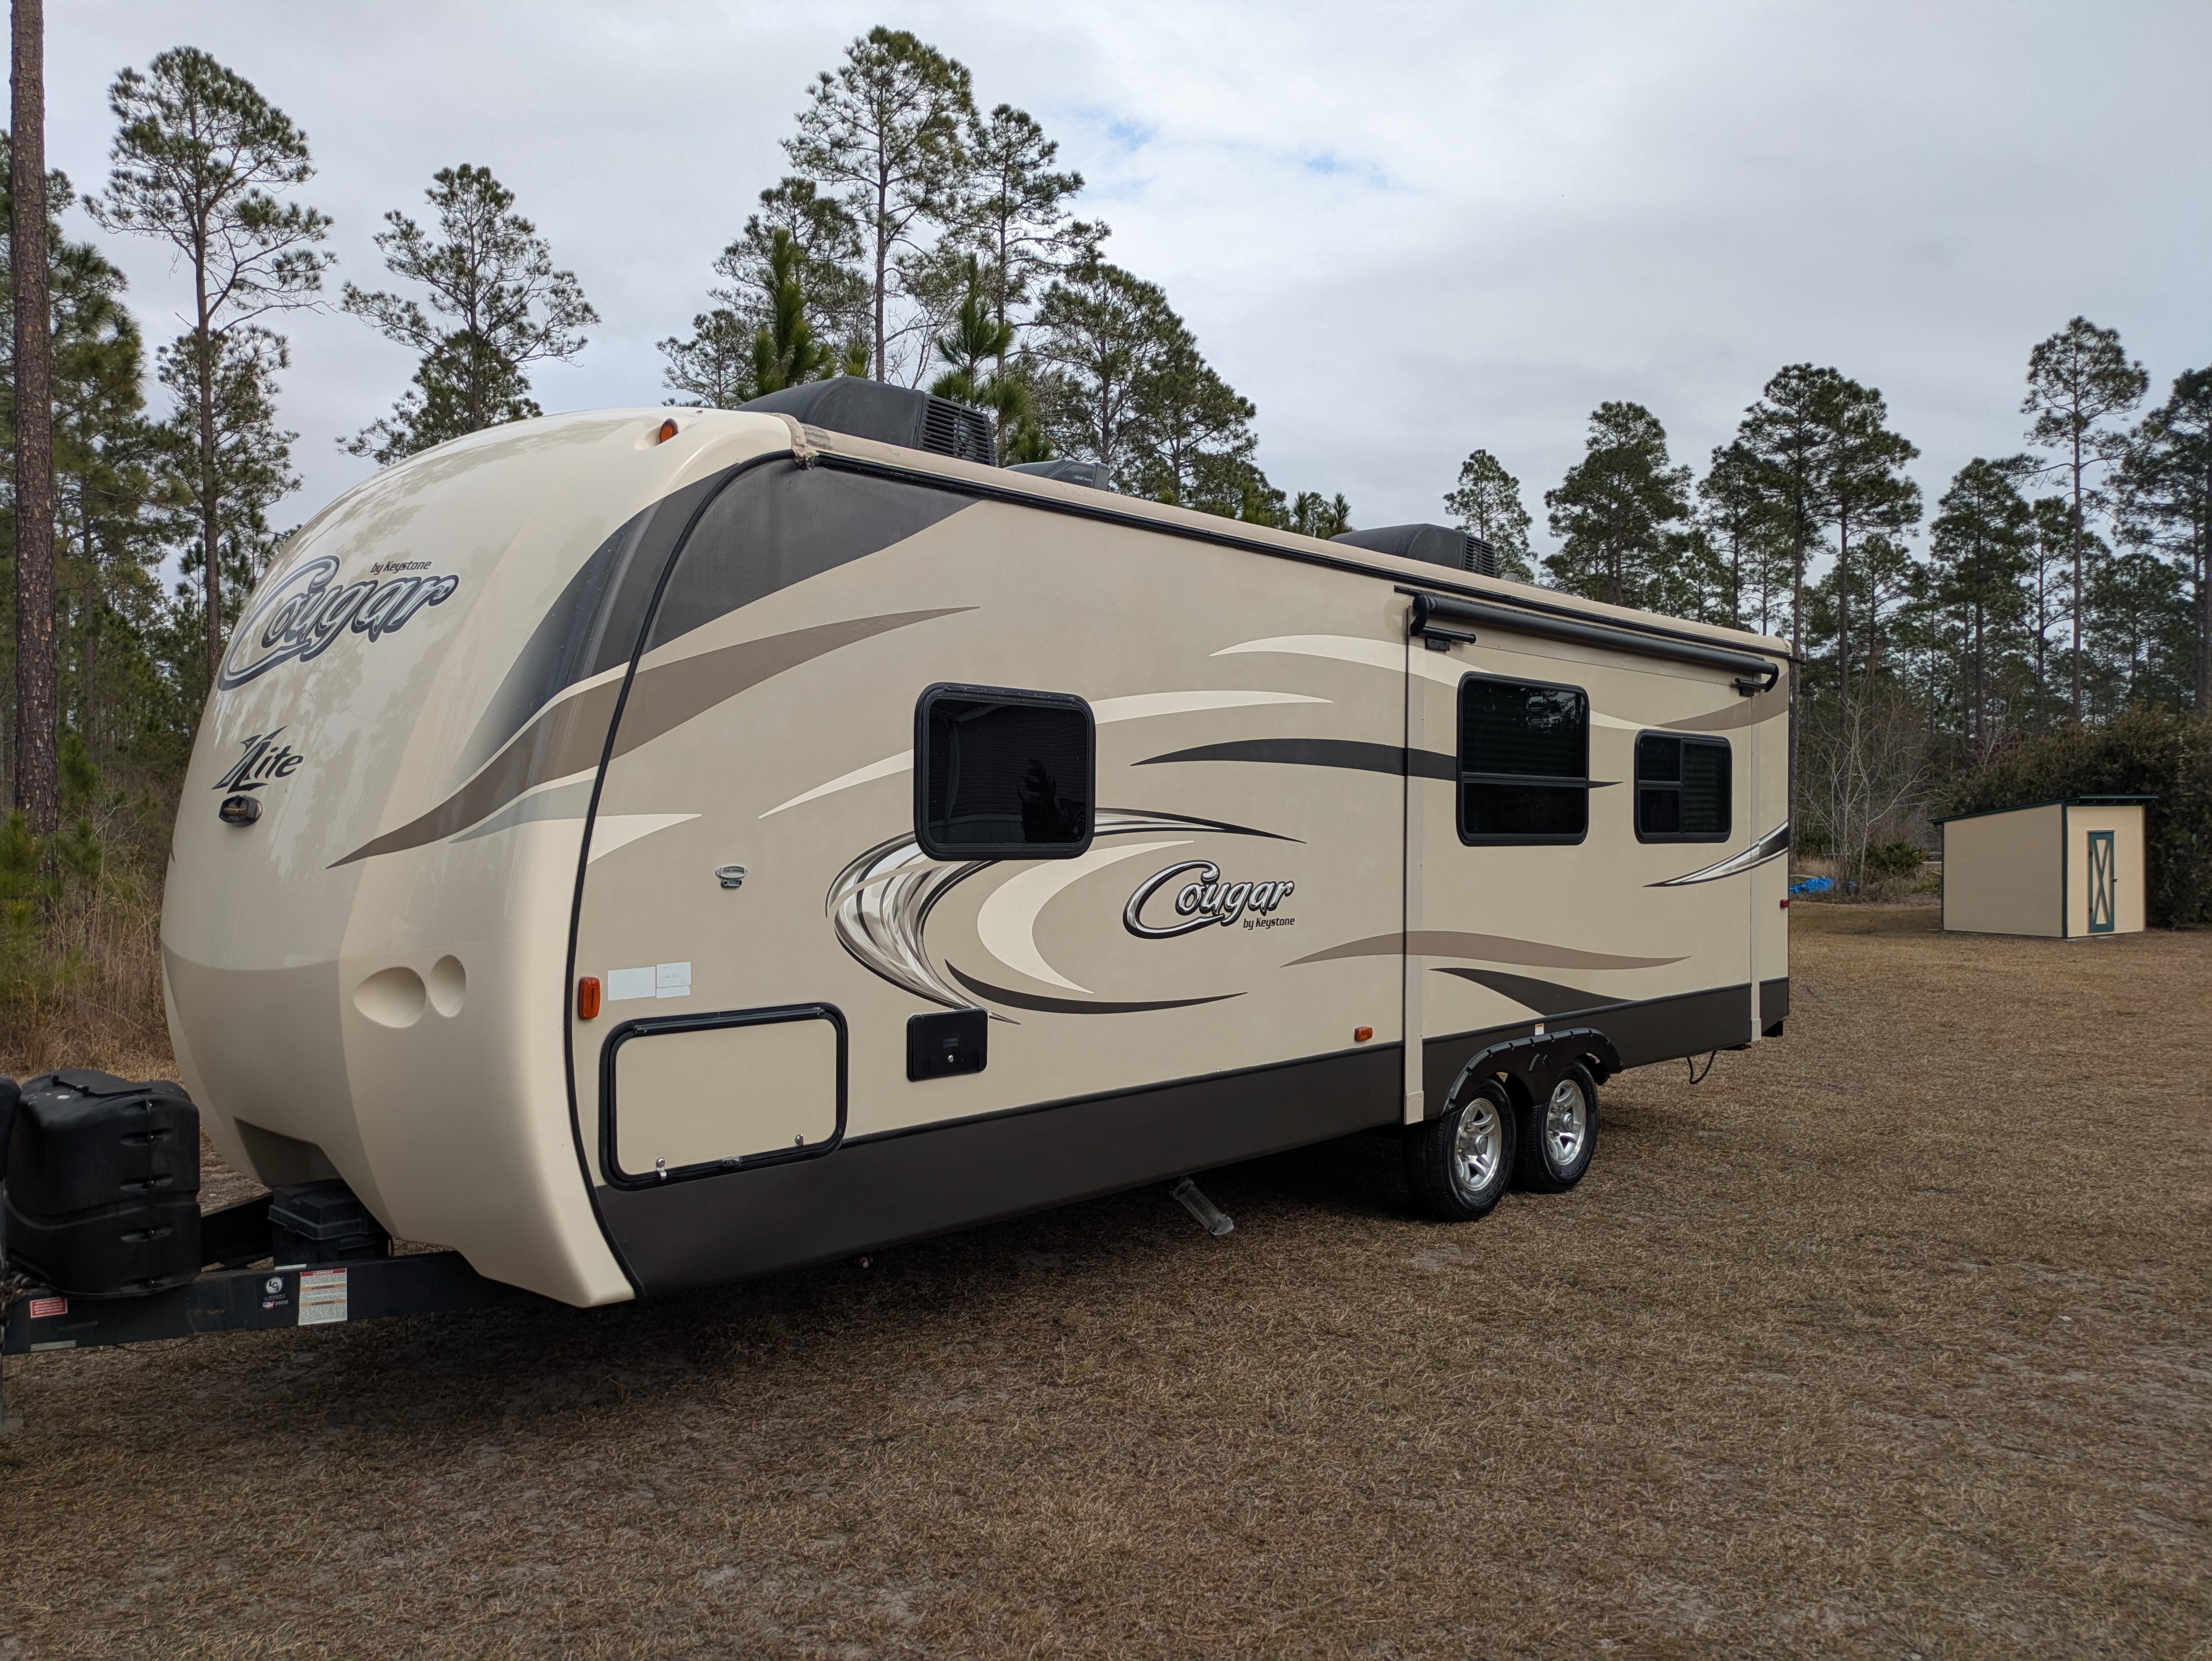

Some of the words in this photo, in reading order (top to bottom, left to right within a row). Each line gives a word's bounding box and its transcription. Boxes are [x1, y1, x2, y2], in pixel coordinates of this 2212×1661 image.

[370, 563, 384, 575] by
[383, 561, 431, 574] Keystone
[218, 555, 459, 691] Cougar
[1123, 860, 1294, 939] Cougar
[1243, 919, 1254, 930] by
[1256, 918, 1295, 929] Keystone
